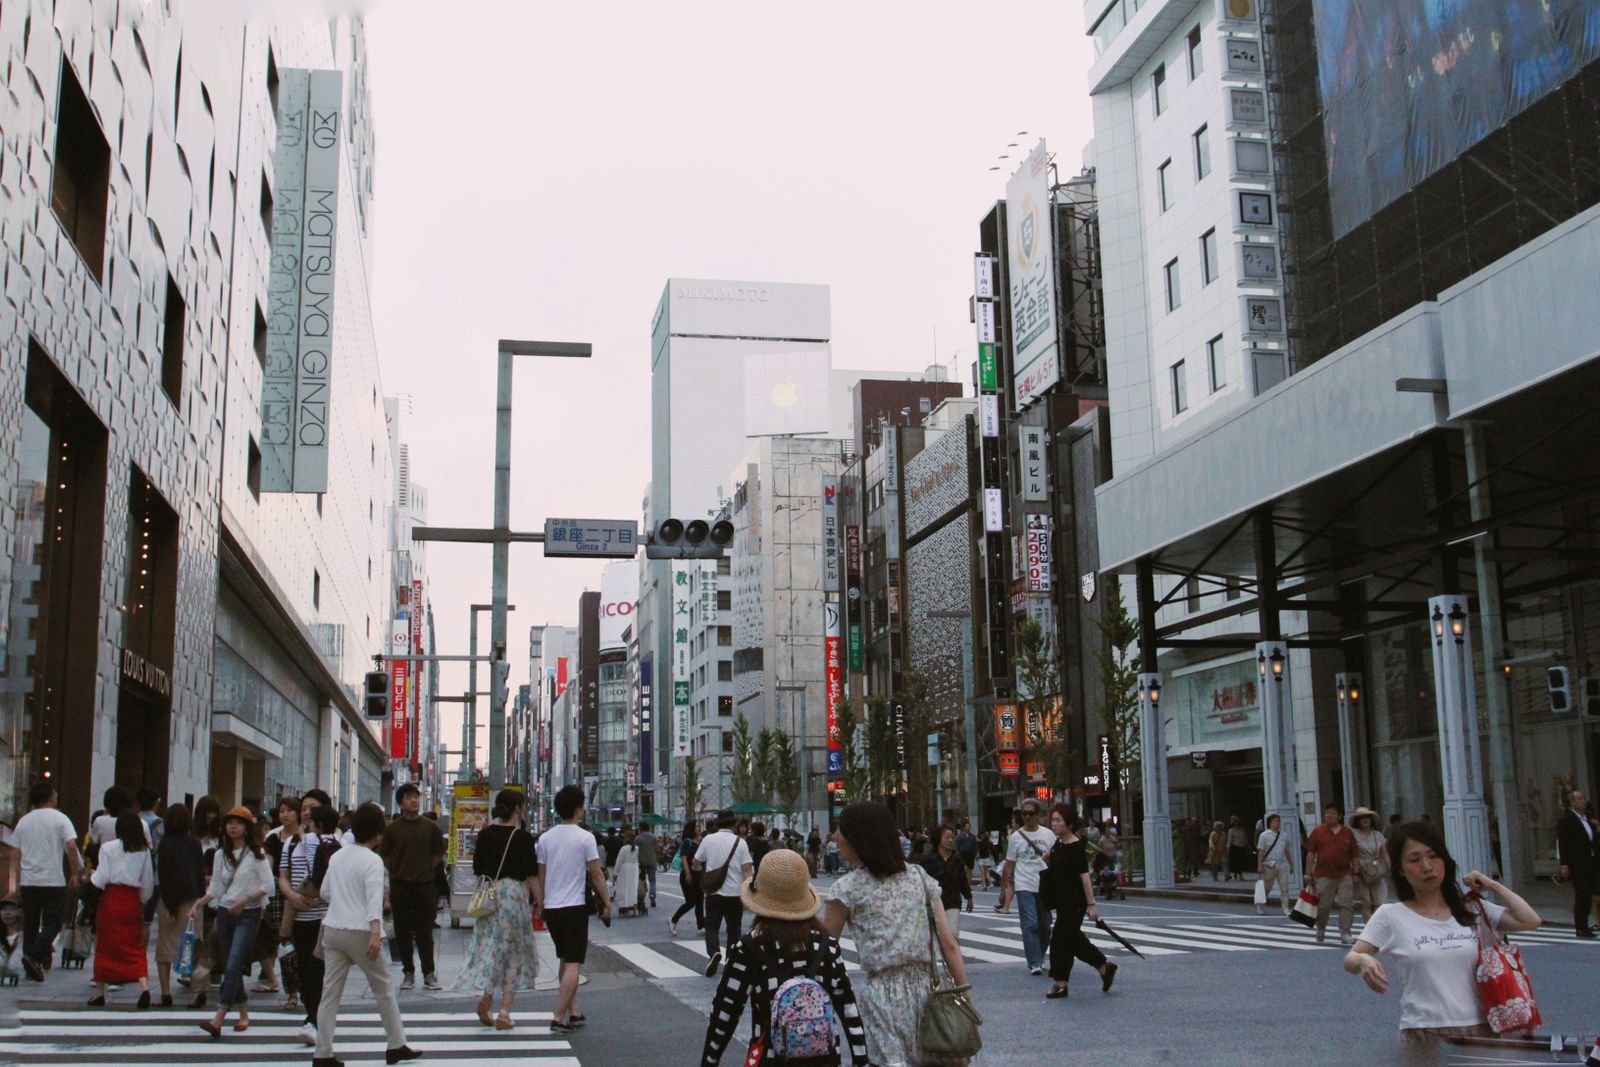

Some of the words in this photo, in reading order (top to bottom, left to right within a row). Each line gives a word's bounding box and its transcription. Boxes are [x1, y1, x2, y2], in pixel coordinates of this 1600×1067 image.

[678, 284, 770, 303] MIKIMOTO
[1013, 254, 1048, 308] シェーン
[1014, 282, 1050, 341] 英会話
[1028, 433, 1041, 494] 南風ビル
[552, 527, 632, 544] 銀座二丁目
[576, 542, 599, 551] Ginza
[602, 543, 609, 551] 2
[1028, 532, 1040, 590] 2990円
[413, 583, 421, 636] MITSUKOSHI
[675, 570, 688, 644] 教文館
[123, 649, 145, 683] LOUIS
[145, 661, 171, 697] VUITTON
[394, 667, 405, 730] 三菱UFJ銀行
[676, 684, 688, 702] 本
